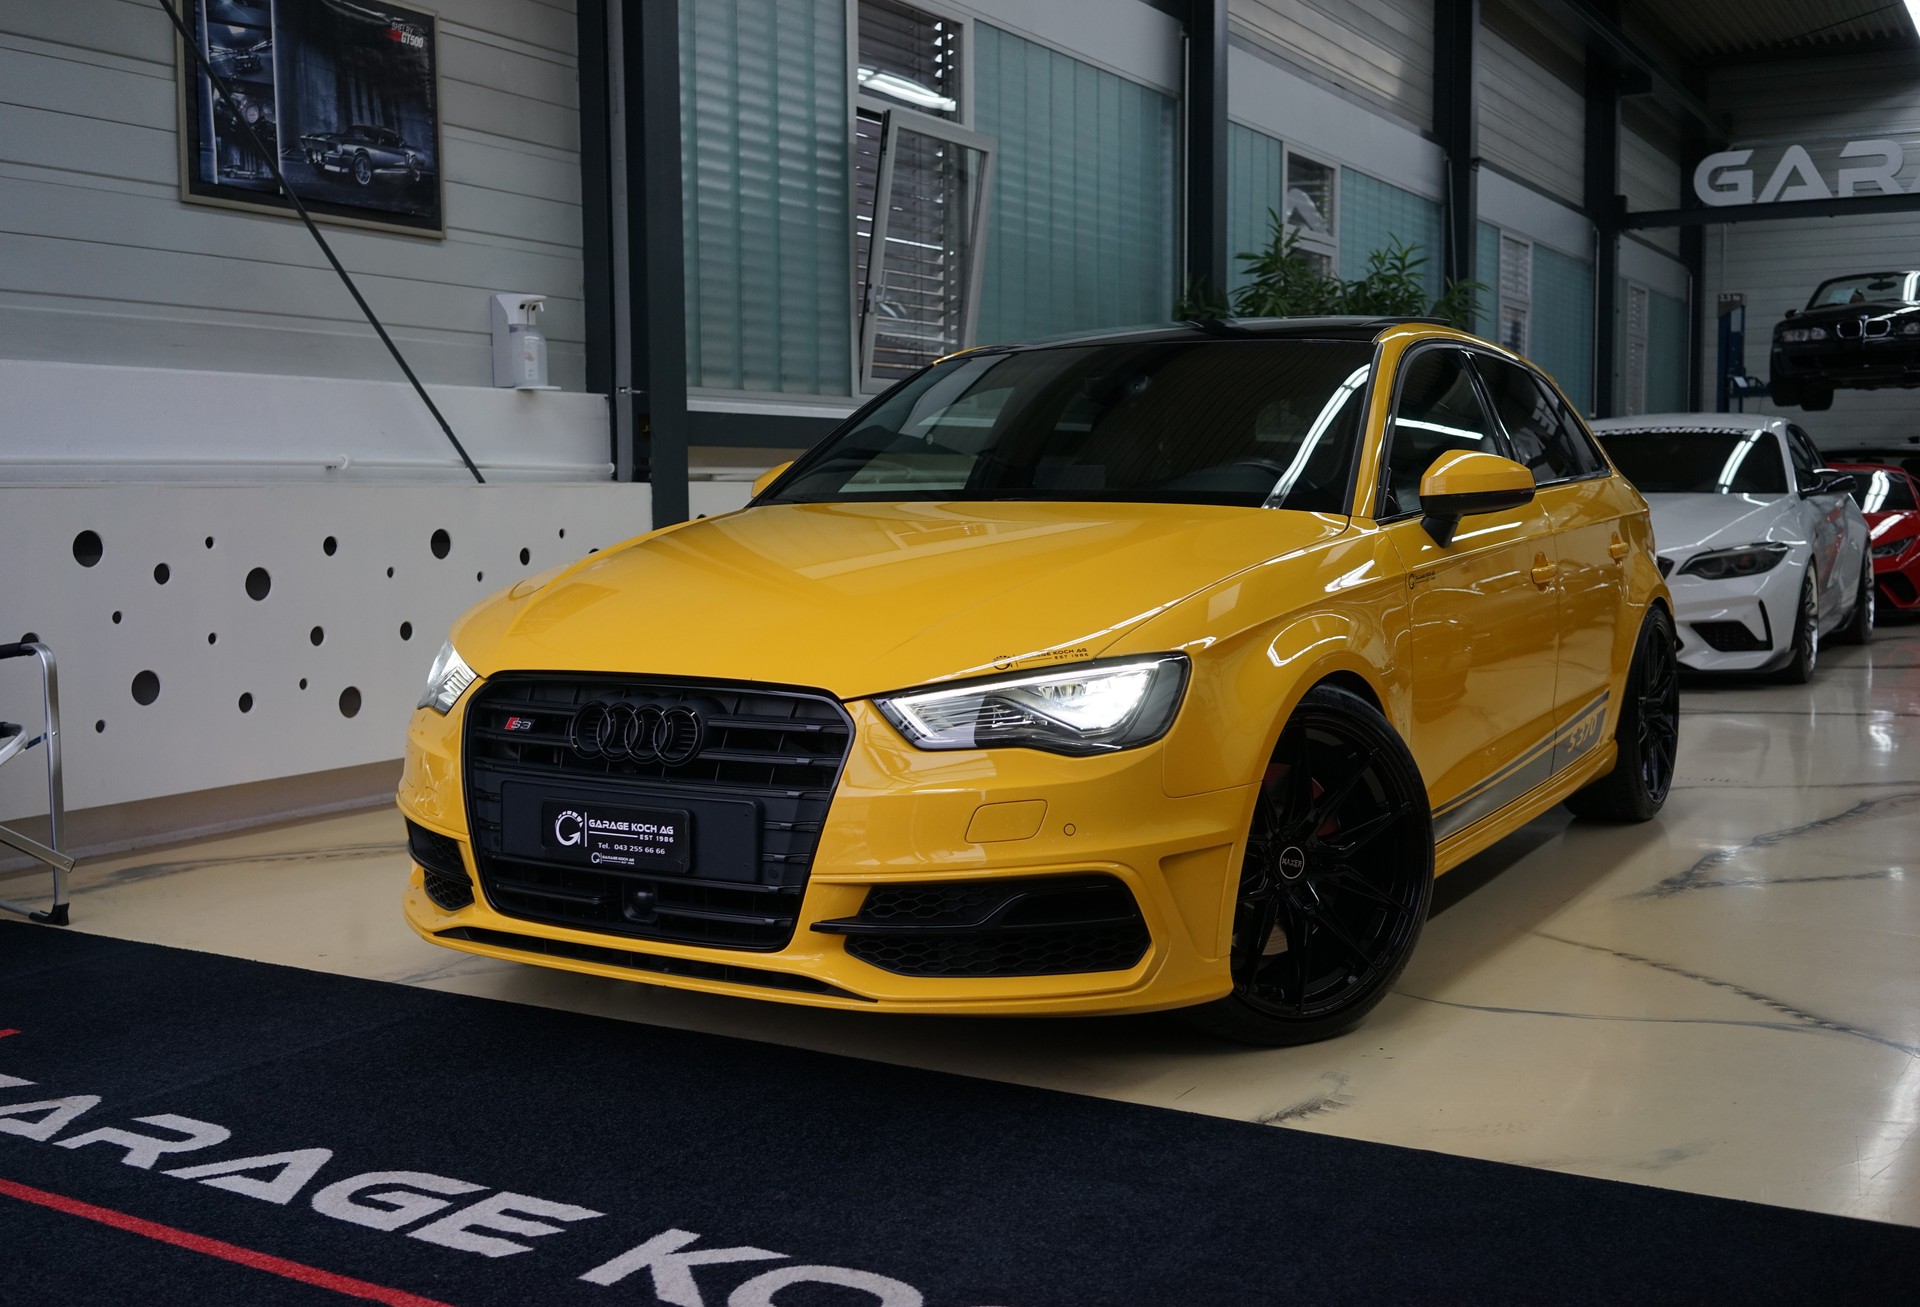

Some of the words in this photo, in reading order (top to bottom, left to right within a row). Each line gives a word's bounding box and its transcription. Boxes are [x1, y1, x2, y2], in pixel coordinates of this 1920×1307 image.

[401, 32, 424, 48] GT500
[1693, 139, 1920, 207] GAR
[511, 720, 532, 730] S3
[588, 819, 629, 831] GARAGE
[631, 823, 657, 833] KOCH
[659, 825, 674, 835] AG
[656, 835, 674, 843] 1986
[598, 842, 611, 850] Tel.
[614, 843, 627, 851] 043
[629, 845, 643, 853] 255
[644, 846, 654, 854] 66
[0, 1074, 607, 1257] ARAGE
